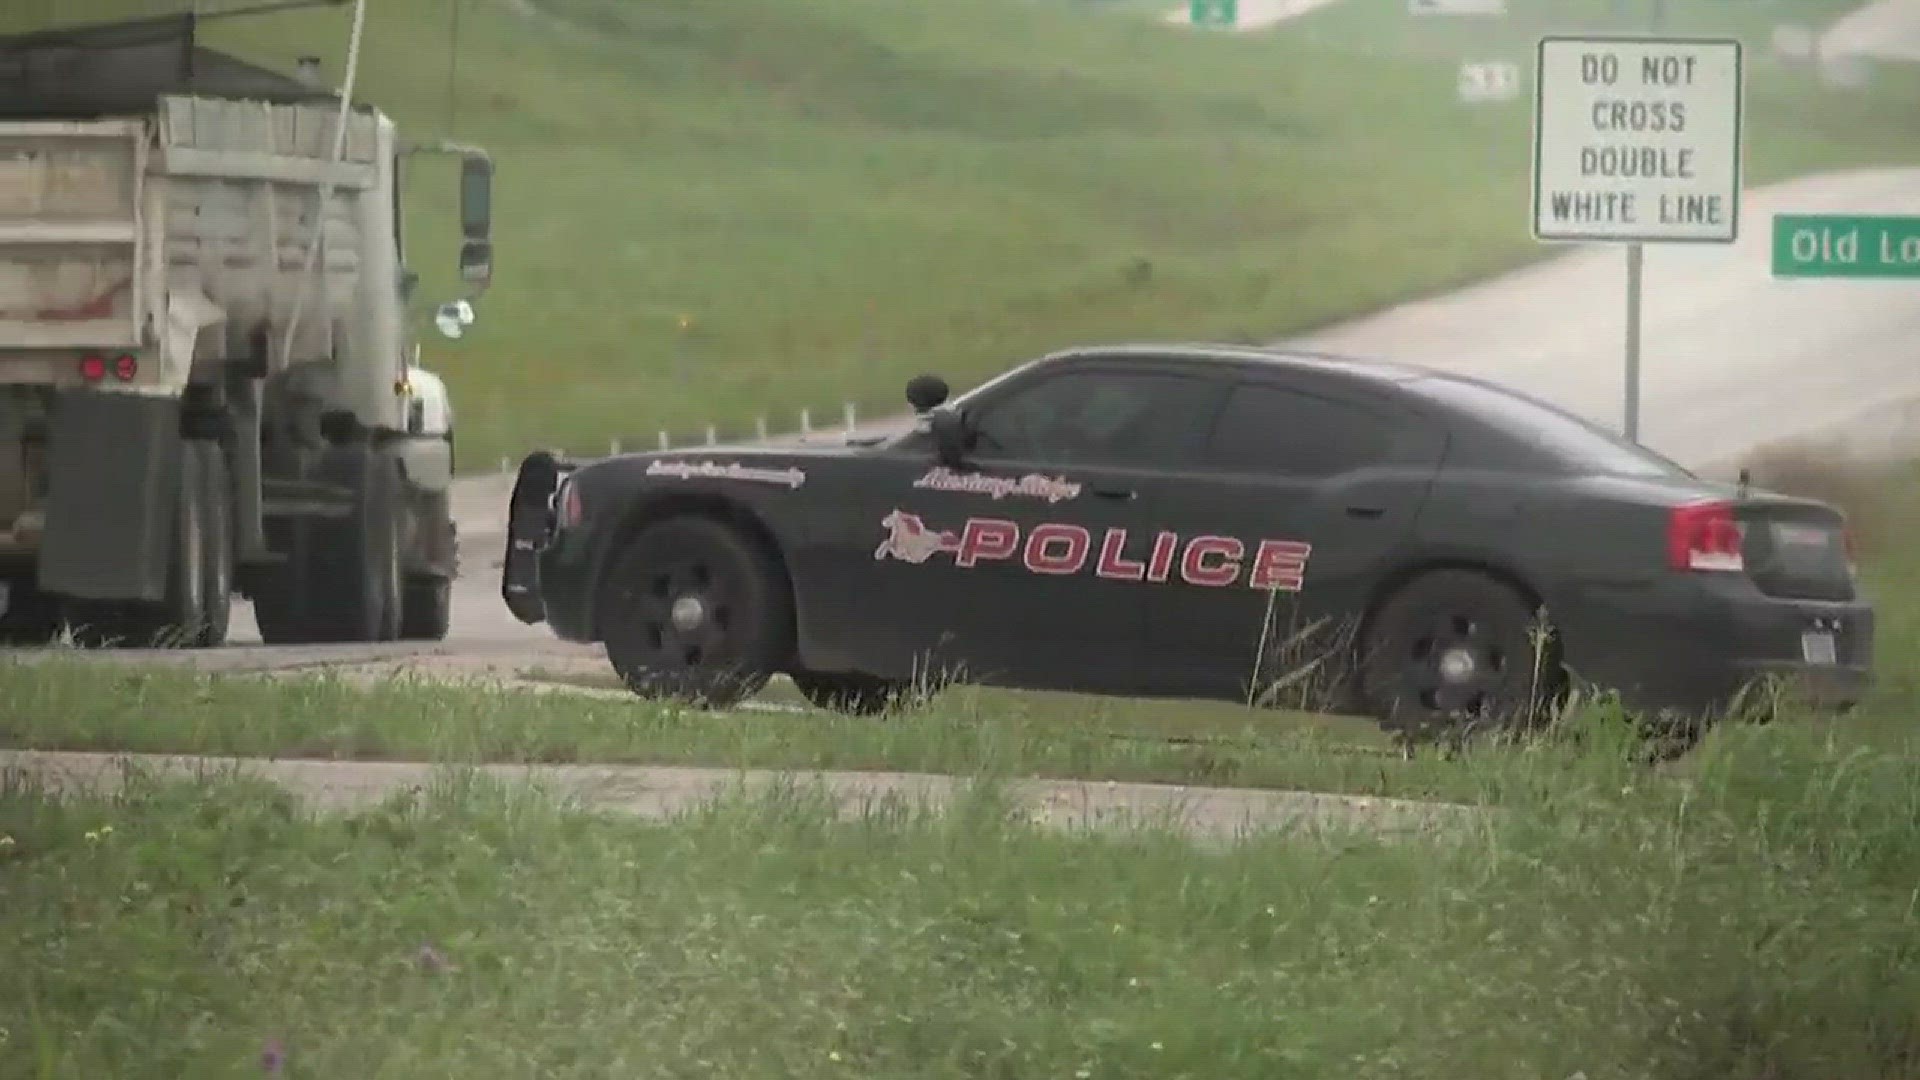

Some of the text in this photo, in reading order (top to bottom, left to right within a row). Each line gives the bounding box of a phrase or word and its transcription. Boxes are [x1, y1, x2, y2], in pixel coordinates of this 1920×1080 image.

[1581, 54, 1697, 86] DO NOT
[1592, 102, 1686, 132] CROSS
[1581, 148, 1694, 178] DOUBLE
[1551, 191, 1723, 225] WHITE LINE
[1791, 228, 1859, 262] Old
[956, 518, 1311, 590] POLICE
